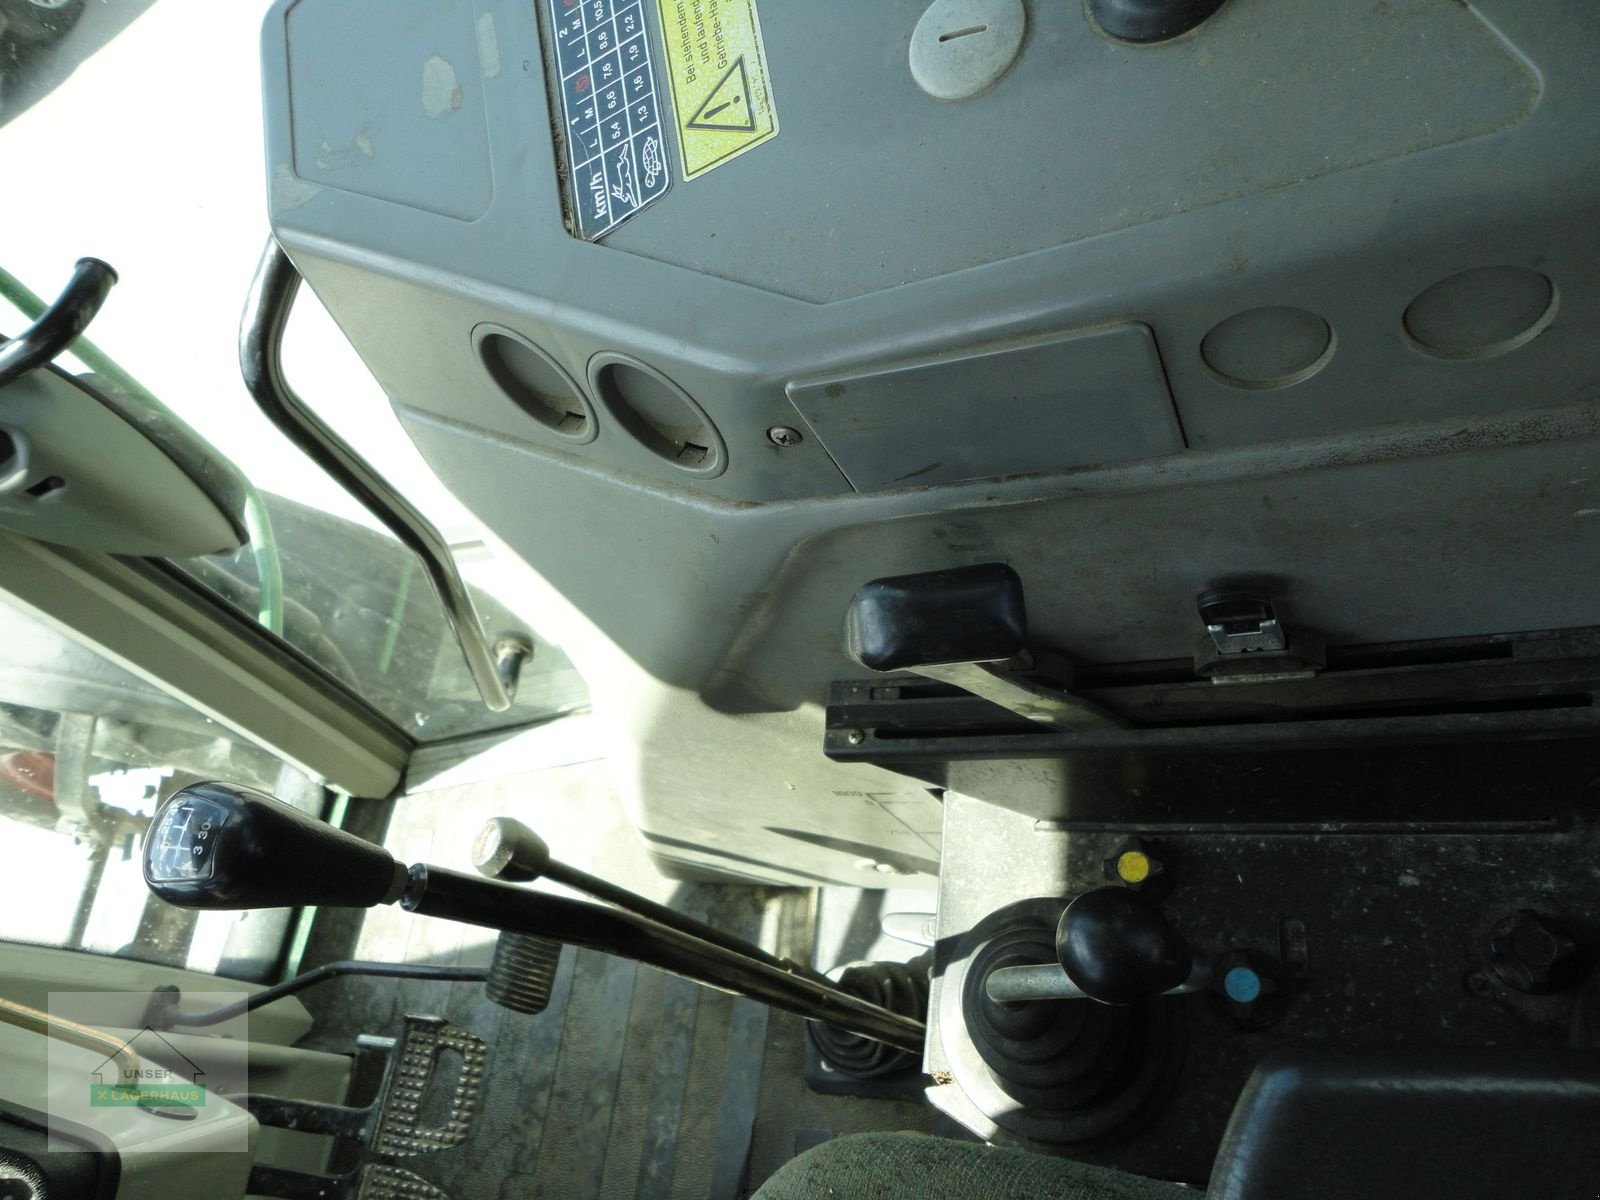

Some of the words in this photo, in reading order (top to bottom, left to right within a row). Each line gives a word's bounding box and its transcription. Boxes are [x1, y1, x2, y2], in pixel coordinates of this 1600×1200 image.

[593, 0, 604, 22] 10,5
[572, 18, 581, 30] M
[624, 14, 635, 32] 2,2
[676, 1, 694, 62] stehendem
[559, 27, 568, 38] 2
[598, 32, 608, 50] 8,6
[709, 0, 728, 69] Getriebe-Ha
[576, 48, 585, 58] L
[629, 44, 640, 61] 1,9
[697, 41, 710, 65] und
[602, 63, 613, 80] 7,6
[686, 63, 697, 84] Bei
[633, 75, 644, 92] 1,6
[606, 91, 617, 109] 6,6
[571, 117, 580, 126] 1
[584, 107, 594, 120] M
[637, 105, 648, 122] 1,3
[611, 122, 622, 140] 5,4
[589, 138, 598, 148] L
[589, 171, 607, 219] km/h
[193, 845, 203, 856] 3
